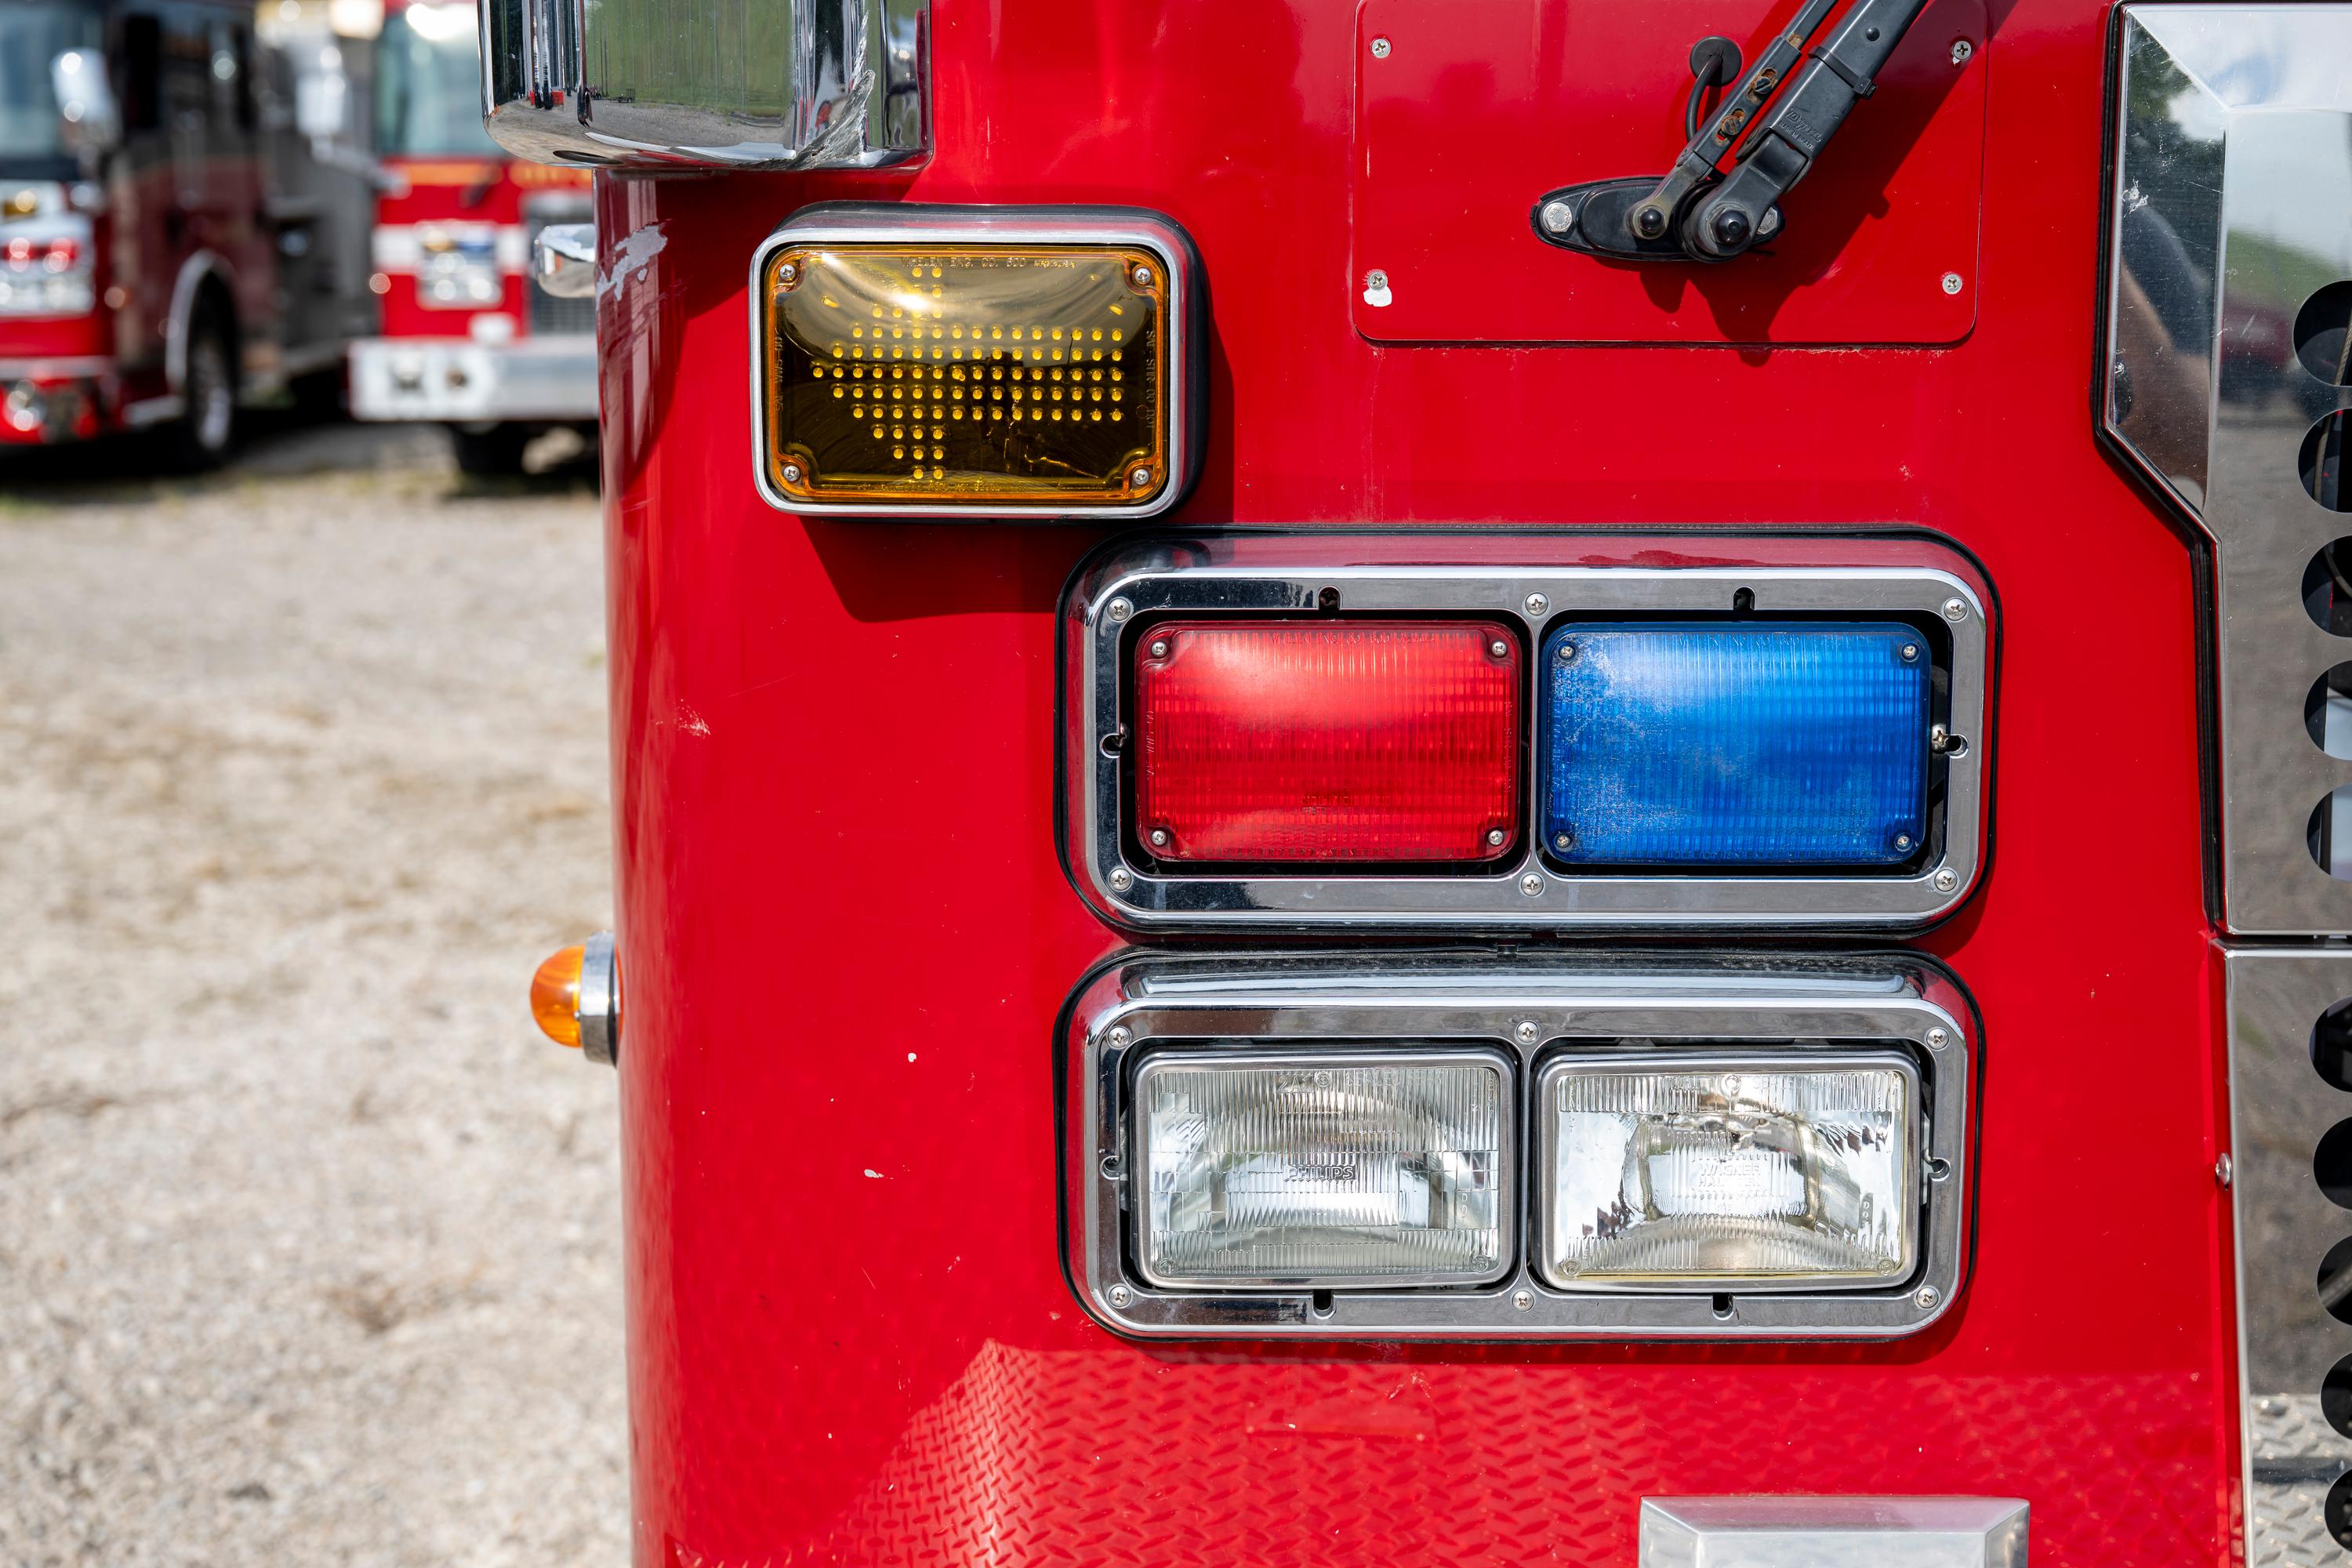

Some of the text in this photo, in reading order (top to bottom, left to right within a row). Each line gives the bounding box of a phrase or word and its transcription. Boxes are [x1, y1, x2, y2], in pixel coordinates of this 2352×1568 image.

[1287, 1165, 1355, 1181] PHILIPS
[1698, 1163, 1762, 1177] WAGNER
[1698, 1176, 1762, 1187] HALEN
